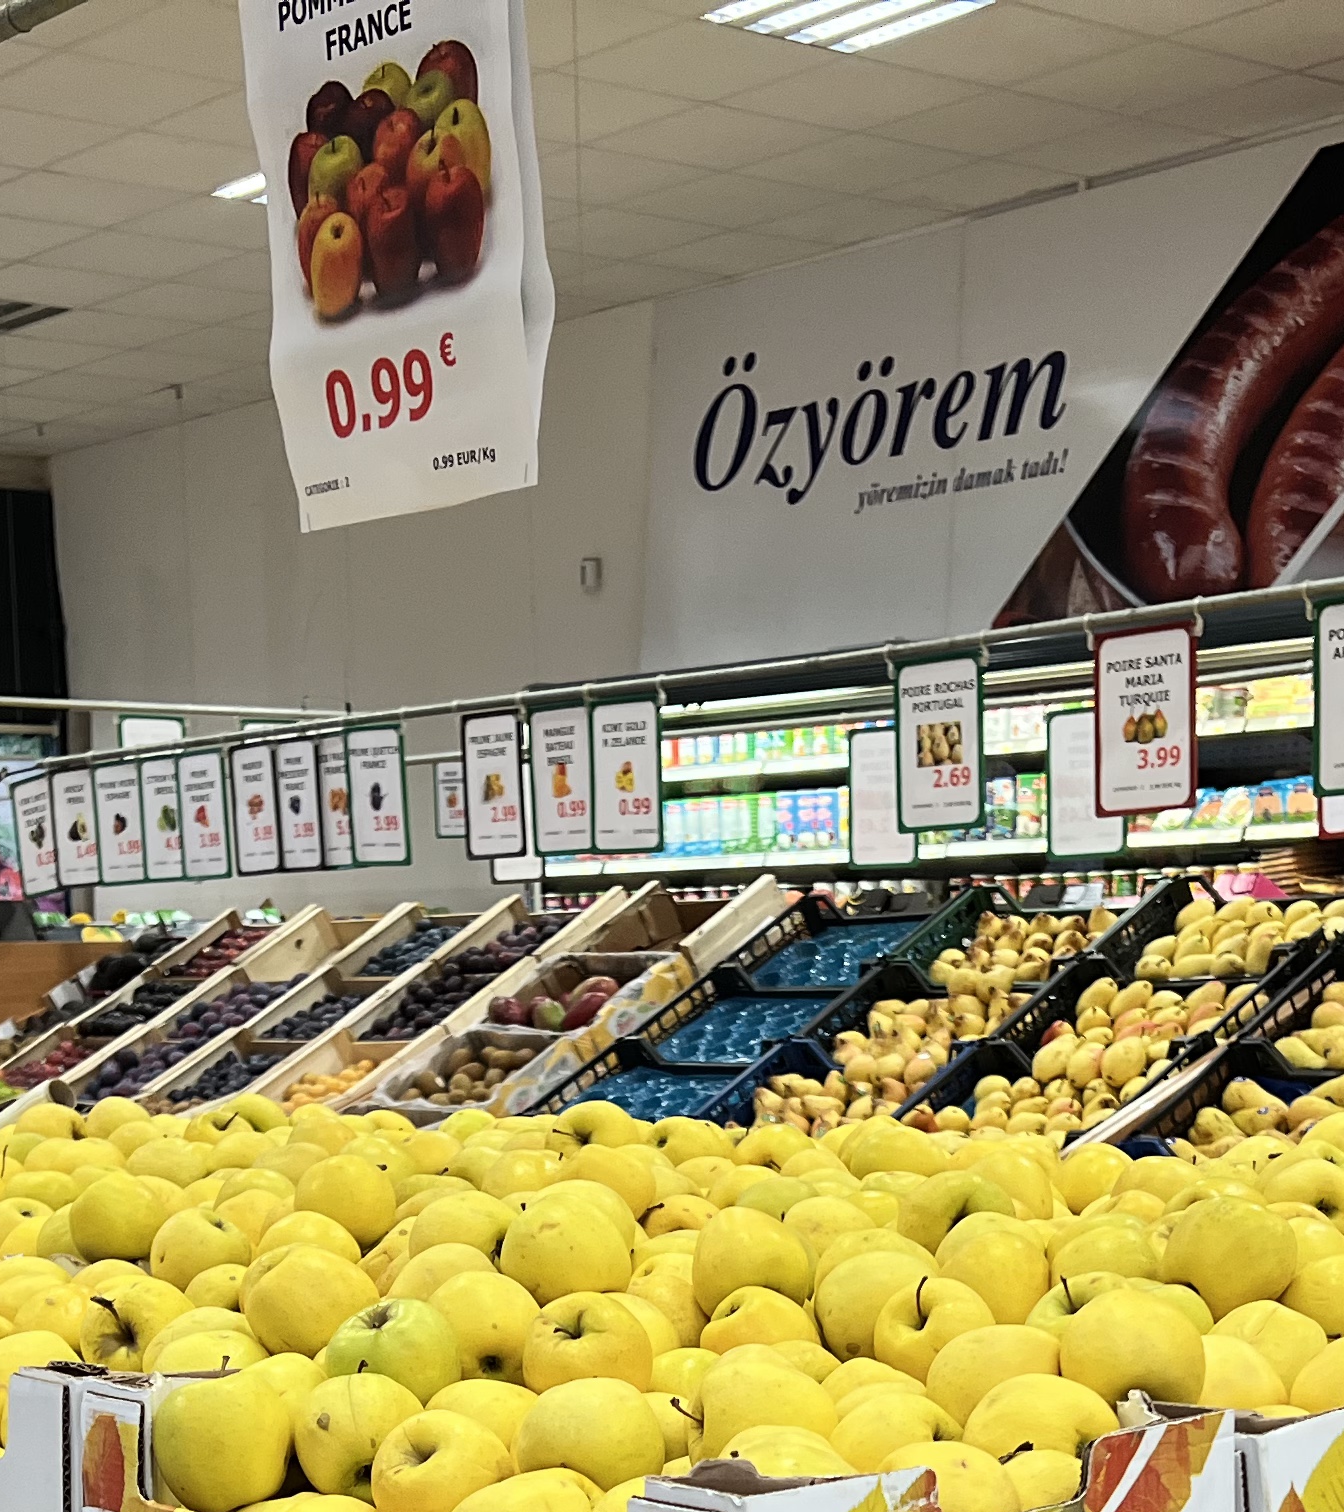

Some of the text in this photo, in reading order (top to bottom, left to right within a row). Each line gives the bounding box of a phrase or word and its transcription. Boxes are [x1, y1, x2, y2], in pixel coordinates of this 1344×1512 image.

[325, 1, 412, 61] FRANCE
[326, 349, 433, 438] 0.99
[693, 351, 1067, 504] Özyörem
[433, 447, 496, 470] 0.99 EUR/Kg
[953, 458, 1017, 492] damak
[1106, 652, 1183, 674] POIRE SANTA
[1125, 673, 1164, 688] MARIA
[1136, 745, 1182, 770] 3.99
[932, 766, 971, 788] 2.69
[618, 798, 651, 815] 0.99
